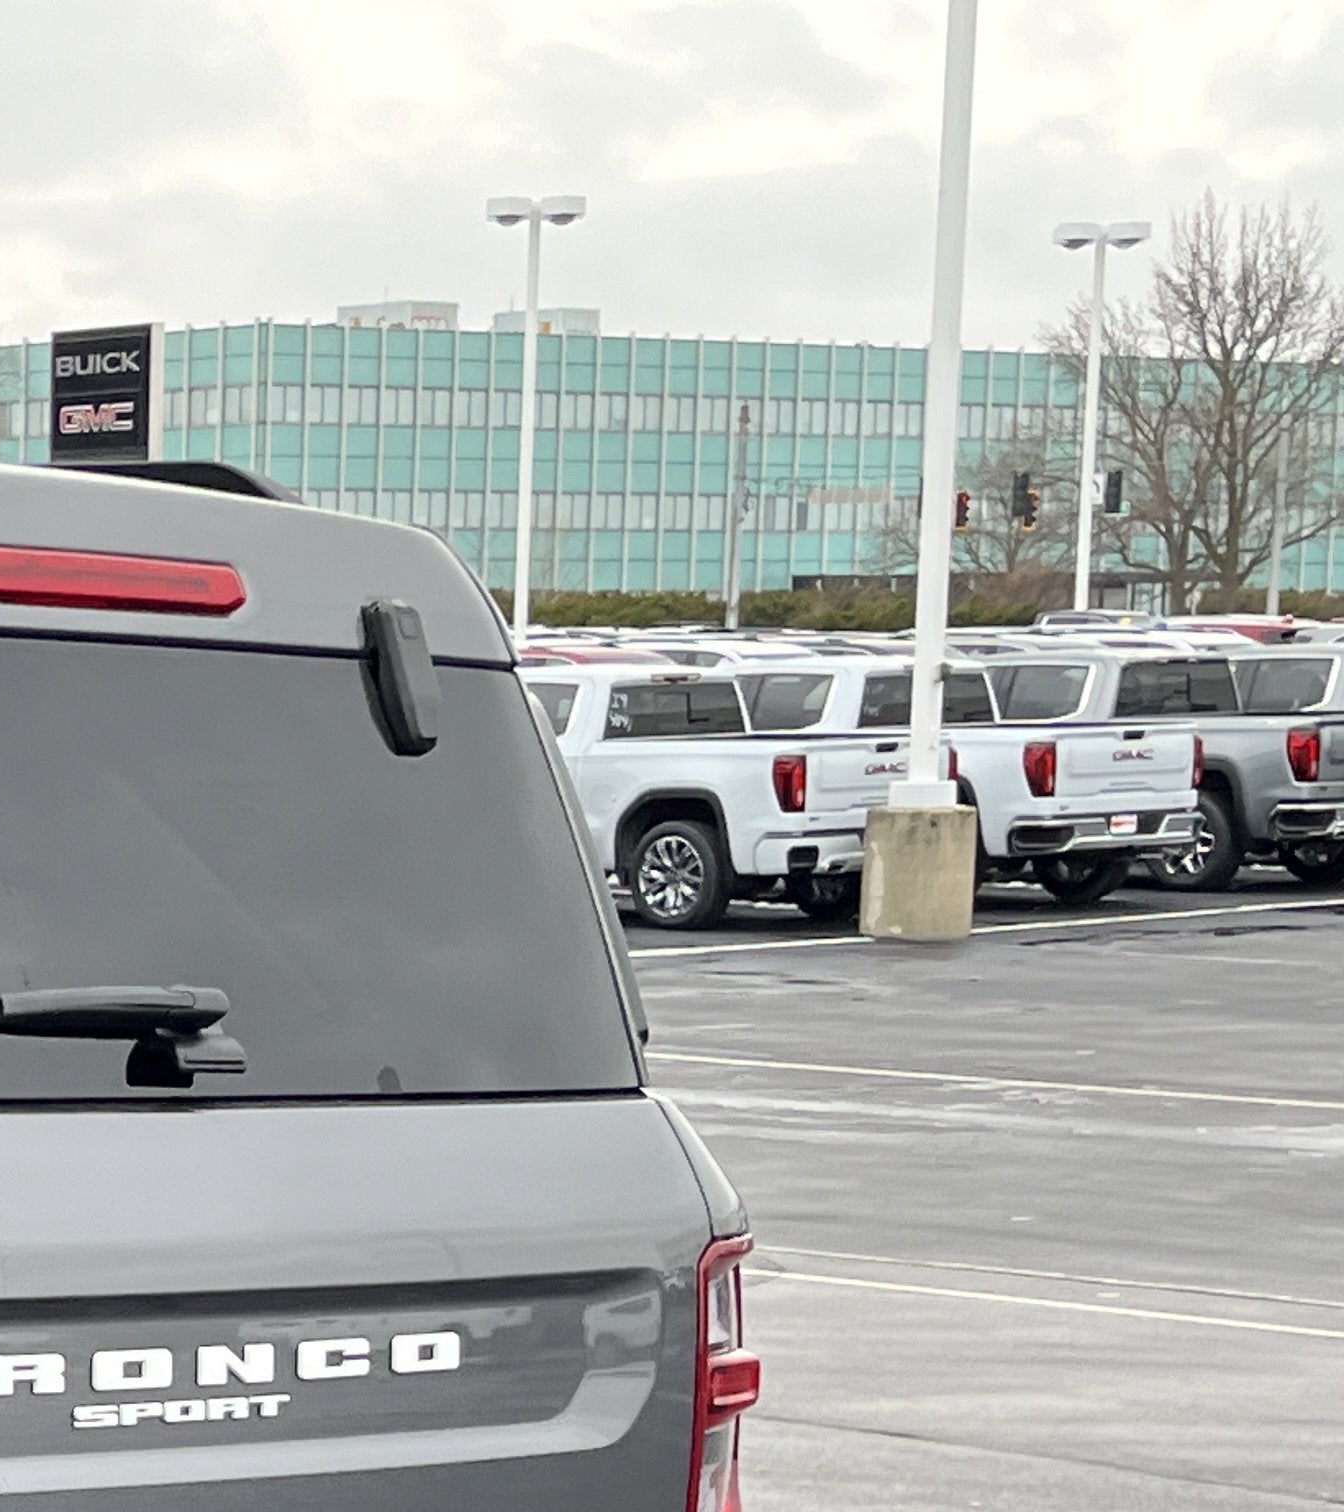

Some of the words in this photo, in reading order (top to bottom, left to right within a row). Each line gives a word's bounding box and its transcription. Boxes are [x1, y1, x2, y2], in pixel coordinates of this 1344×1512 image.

[55, 351, 141, 378] BUICK
[59, 402, 135, 434] GMC
[72, 1394, 291, 1429] SPORT
